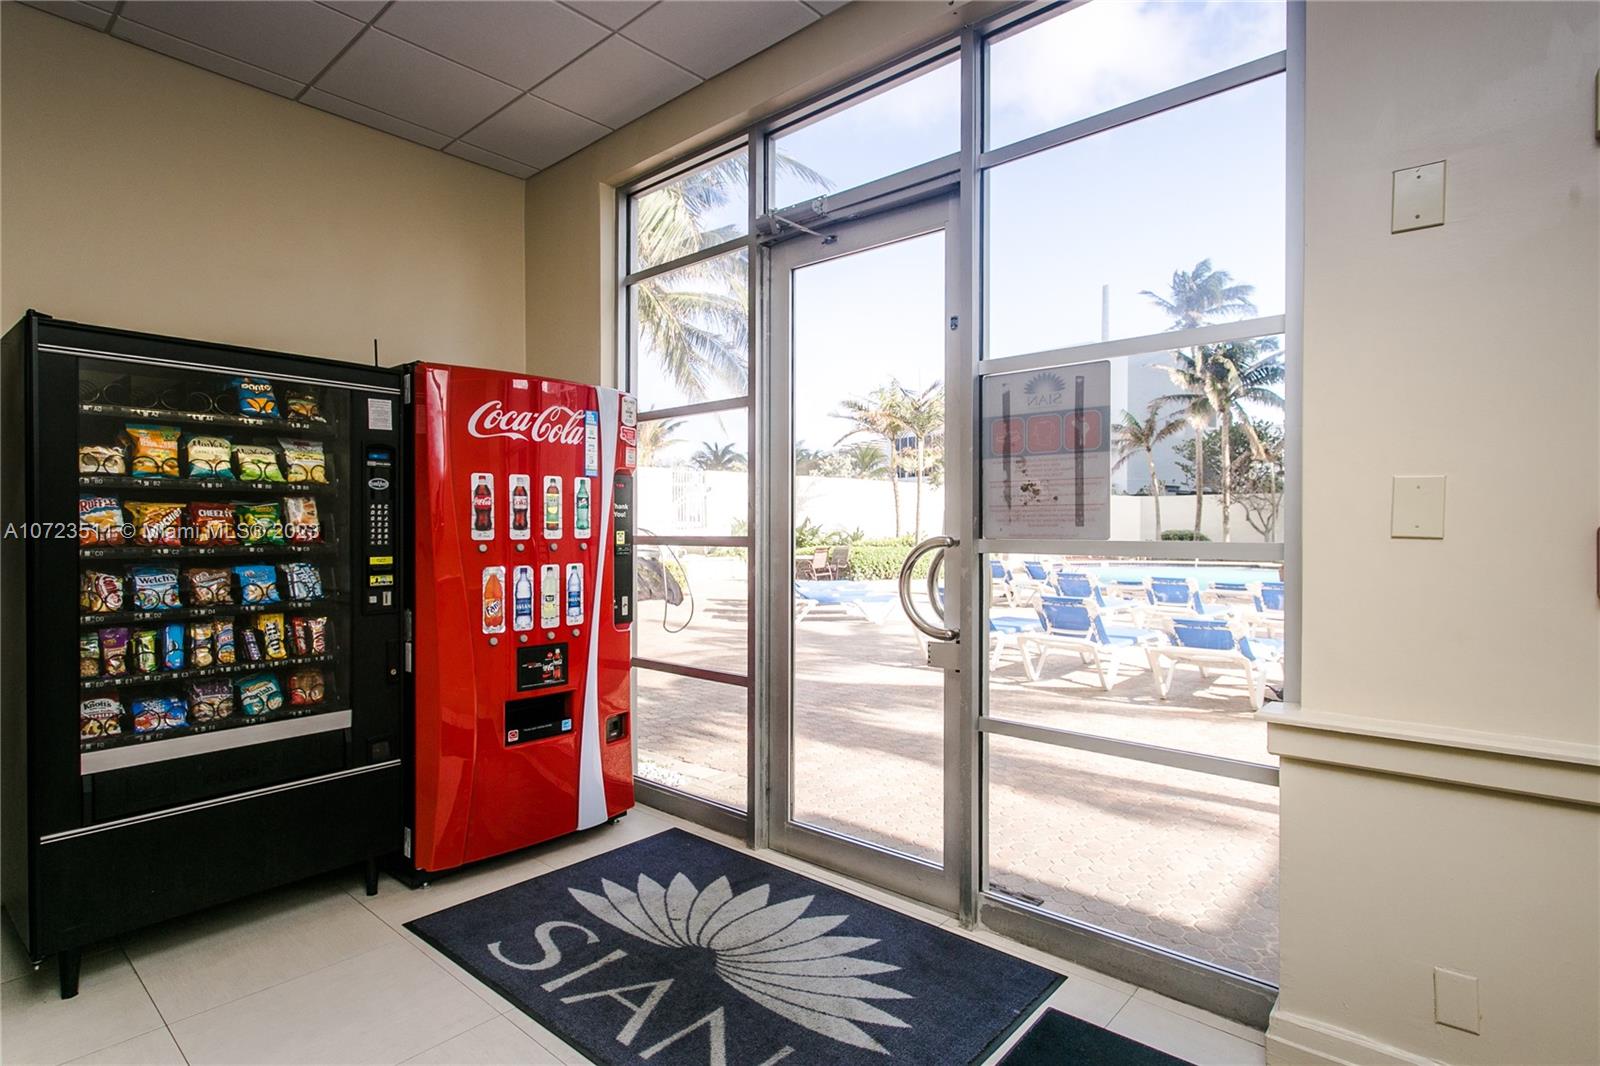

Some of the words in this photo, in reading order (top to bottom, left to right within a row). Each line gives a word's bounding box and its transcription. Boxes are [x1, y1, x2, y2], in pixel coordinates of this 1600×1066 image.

[467, 400, 585, 445] Coca-Cola
[139, 575, 175, 585] Welch's
[83, 701, 112, 711] Knott's
